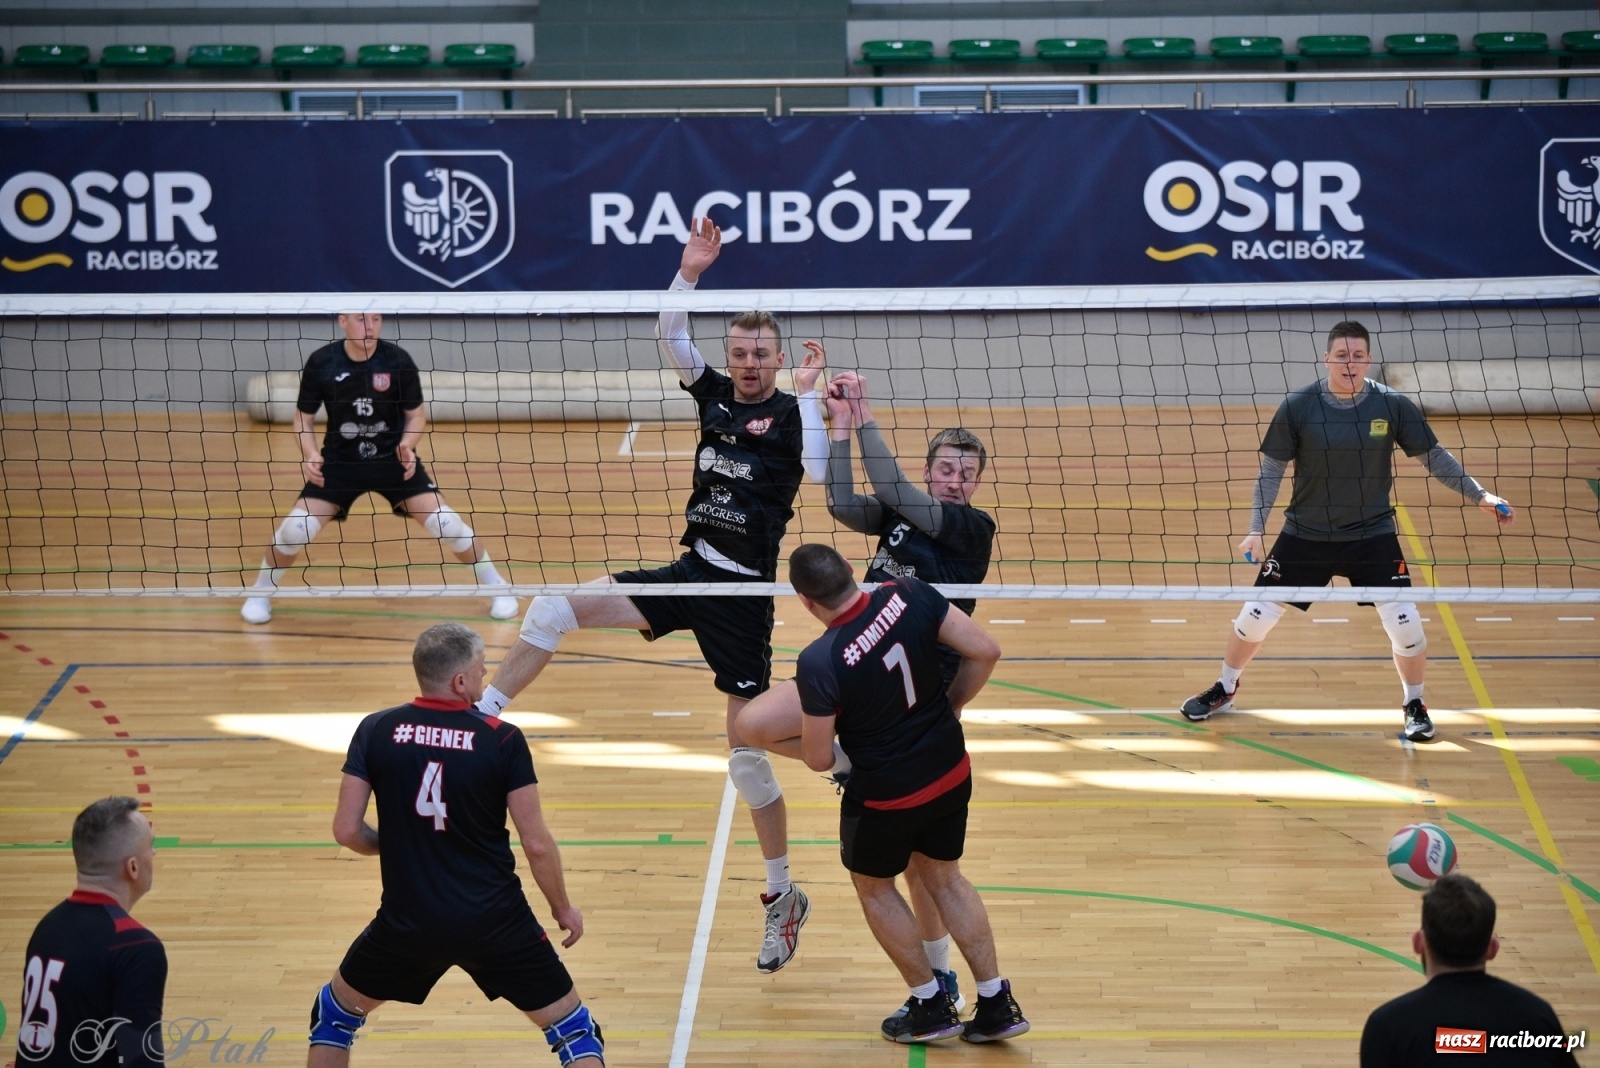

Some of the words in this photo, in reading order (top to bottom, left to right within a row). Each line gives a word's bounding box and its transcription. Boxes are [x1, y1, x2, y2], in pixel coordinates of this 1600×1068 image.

[589, 169, 972, 246] RACIBÓRZ
[86, 244, 219, 271] RACIBÓRZ
[1231, 233, 1365, 261] RACIBÓRZ
[352, 398, 374, 417] 15
[888, 522, 911, 547] 5
[882, 642, 917, 709] 7
[416, 761, 448, 831] 4
[20, 954, 65, 1050] 25
